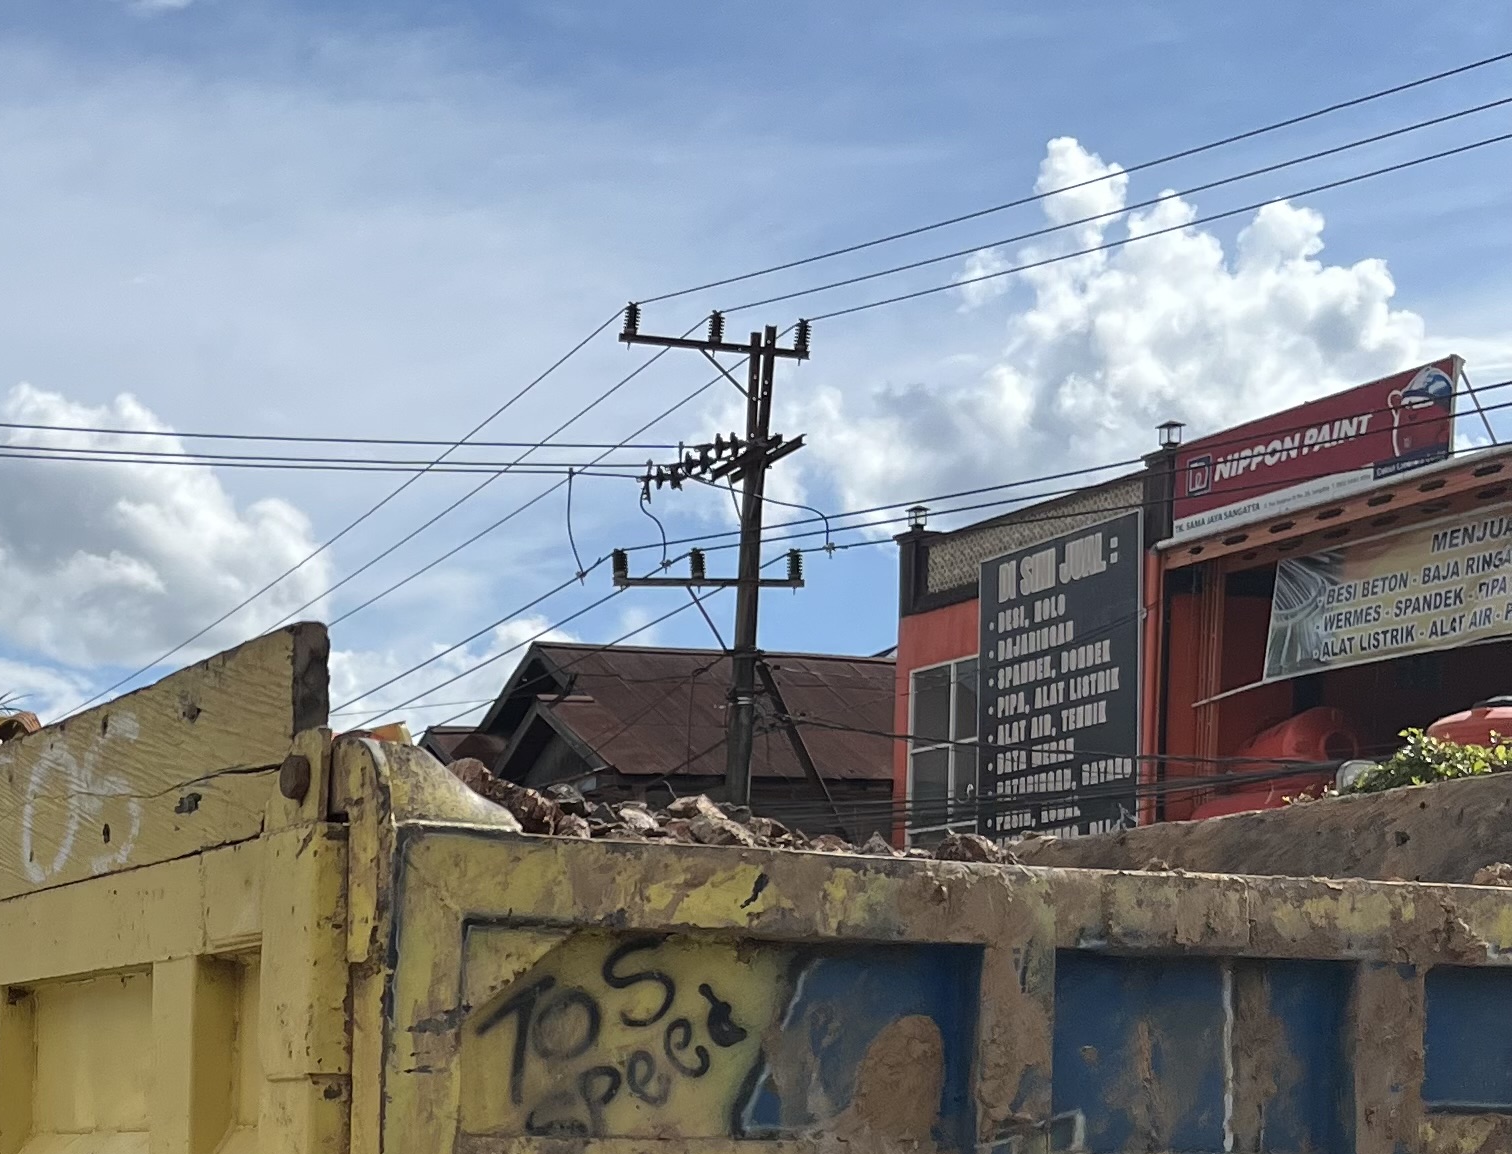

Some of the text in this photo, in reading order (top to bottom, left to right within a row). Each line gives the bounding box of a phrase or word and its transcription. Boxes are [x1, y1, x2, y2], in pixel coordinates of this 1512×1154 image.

[1214, 413, 1374, 483] NIPPON PAINT
[1326, 583, 1358, 606] BESI
[1361, 571, 1409, 598] BETON
[1421, 560, 1460, 585] BAJA
[1322, 636, 1355, 660] ALAT
[1359, 624, 1415, 651] LISTRIK
[1428, 613, 1465, 639] ALAT
[1468, 607, 1492, 630] AIR
[1323, 604, 1382, 632] WERMES
[1393, 587, 1464, 618] SPANDEK
[997, 666, 1120, 719] PIPA, ALAT LISTRIK
[996, 719, 1027, 746] ALAT
